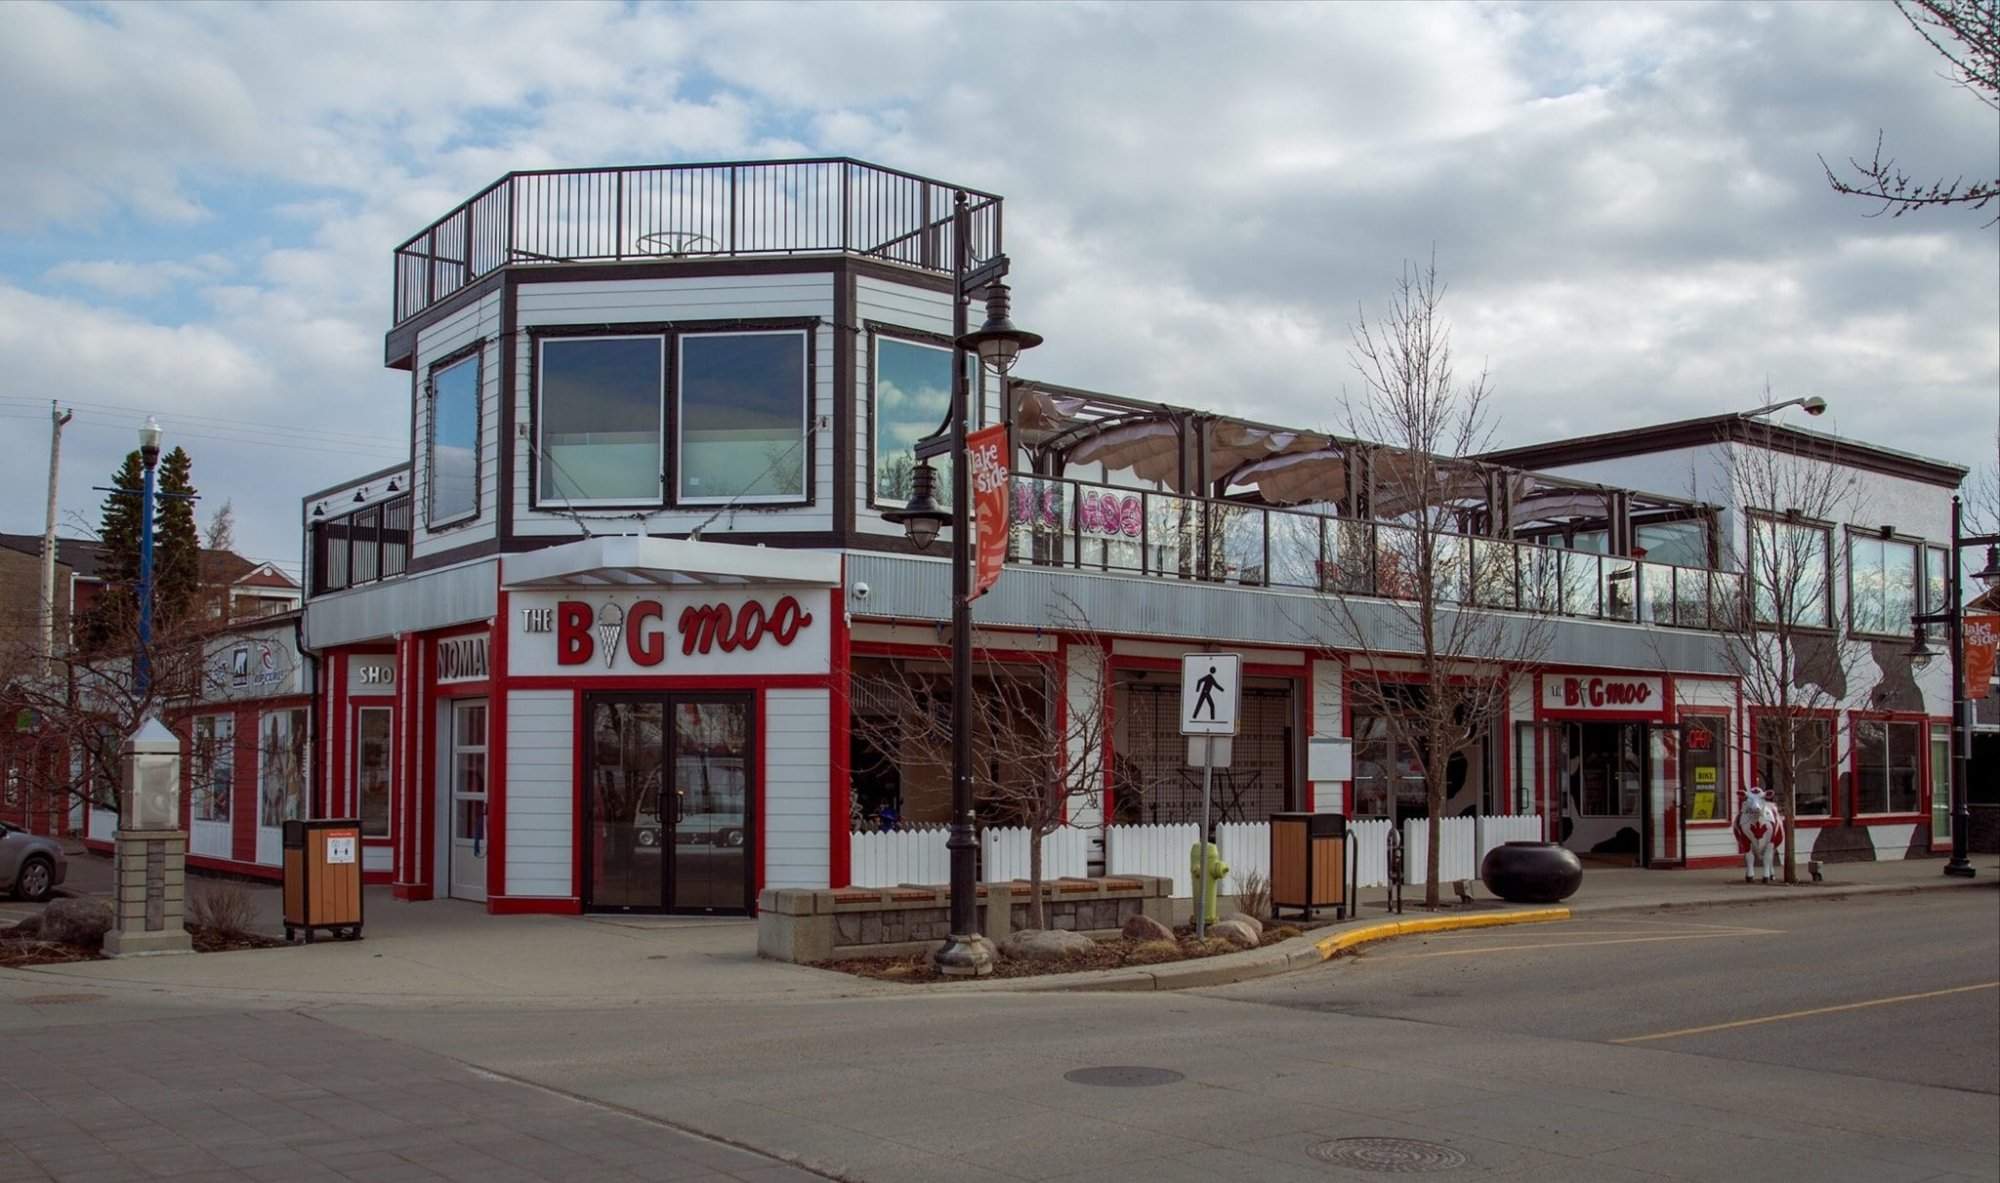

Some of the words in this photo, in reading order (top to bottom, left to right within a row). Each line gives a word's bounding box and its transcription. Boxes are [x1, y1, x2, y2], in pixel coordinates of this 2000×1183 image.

[968, 443, 998, 474] lake
[977, 464, 1009, 493] side
[521, 608, 552, 633] THE
[1964, 622, 1992, 636] lake
[438, 637, 490, 679] NOMA
